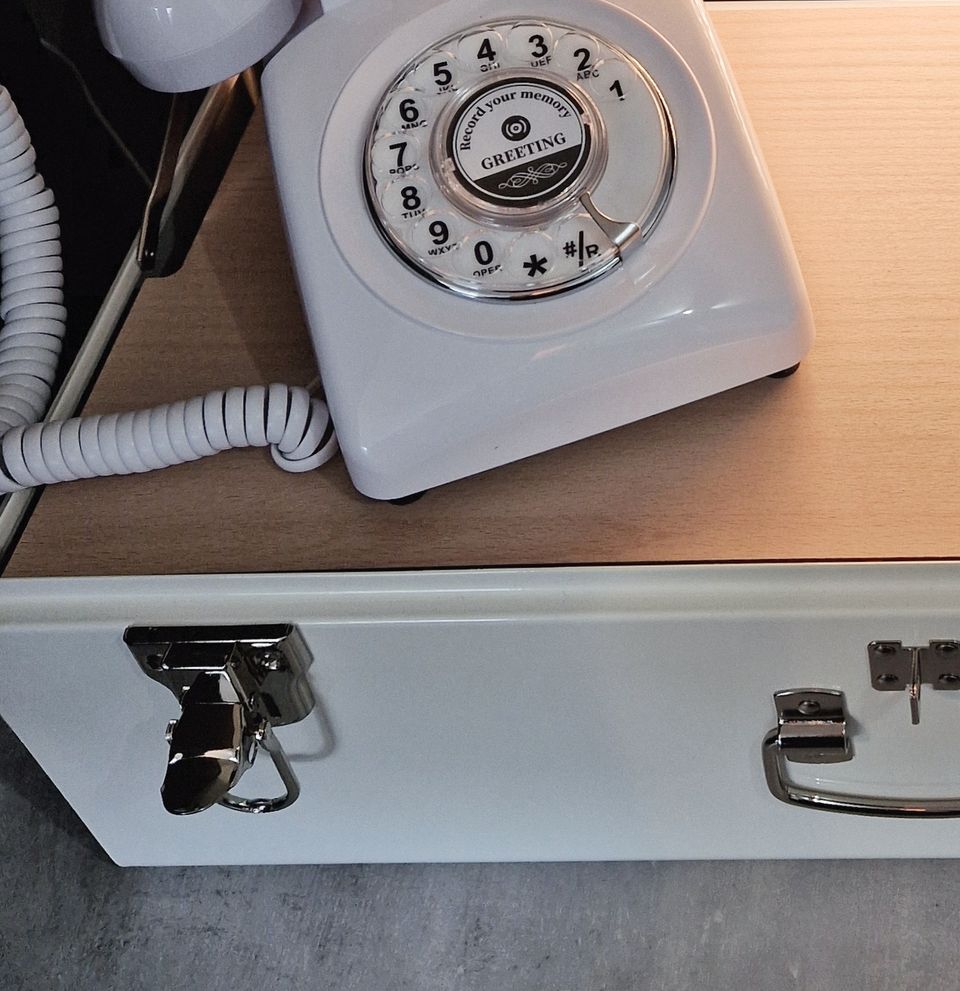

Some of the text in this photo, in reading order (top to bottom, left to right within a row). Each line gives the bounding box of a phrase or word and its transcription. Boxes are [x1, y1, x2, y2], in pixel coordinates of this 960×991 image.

[477, 38, 496, 61] 4
[528, 35, 548, 59] 3
[573, 48, 593, 72] 2
[433, 61, 452, 86] 5
[576, 68, 600, 82] ABC
[609, 79, 626, 102] 1
[399, 99, 419, 123] 6
[460, 90, 572, 151] Record your memory
[389, 142, 407, 167] 7
[481, 132, 567, 170] GREETING
[401, 186, 421, 210] 8
[429, 221, 449, 245] 9
